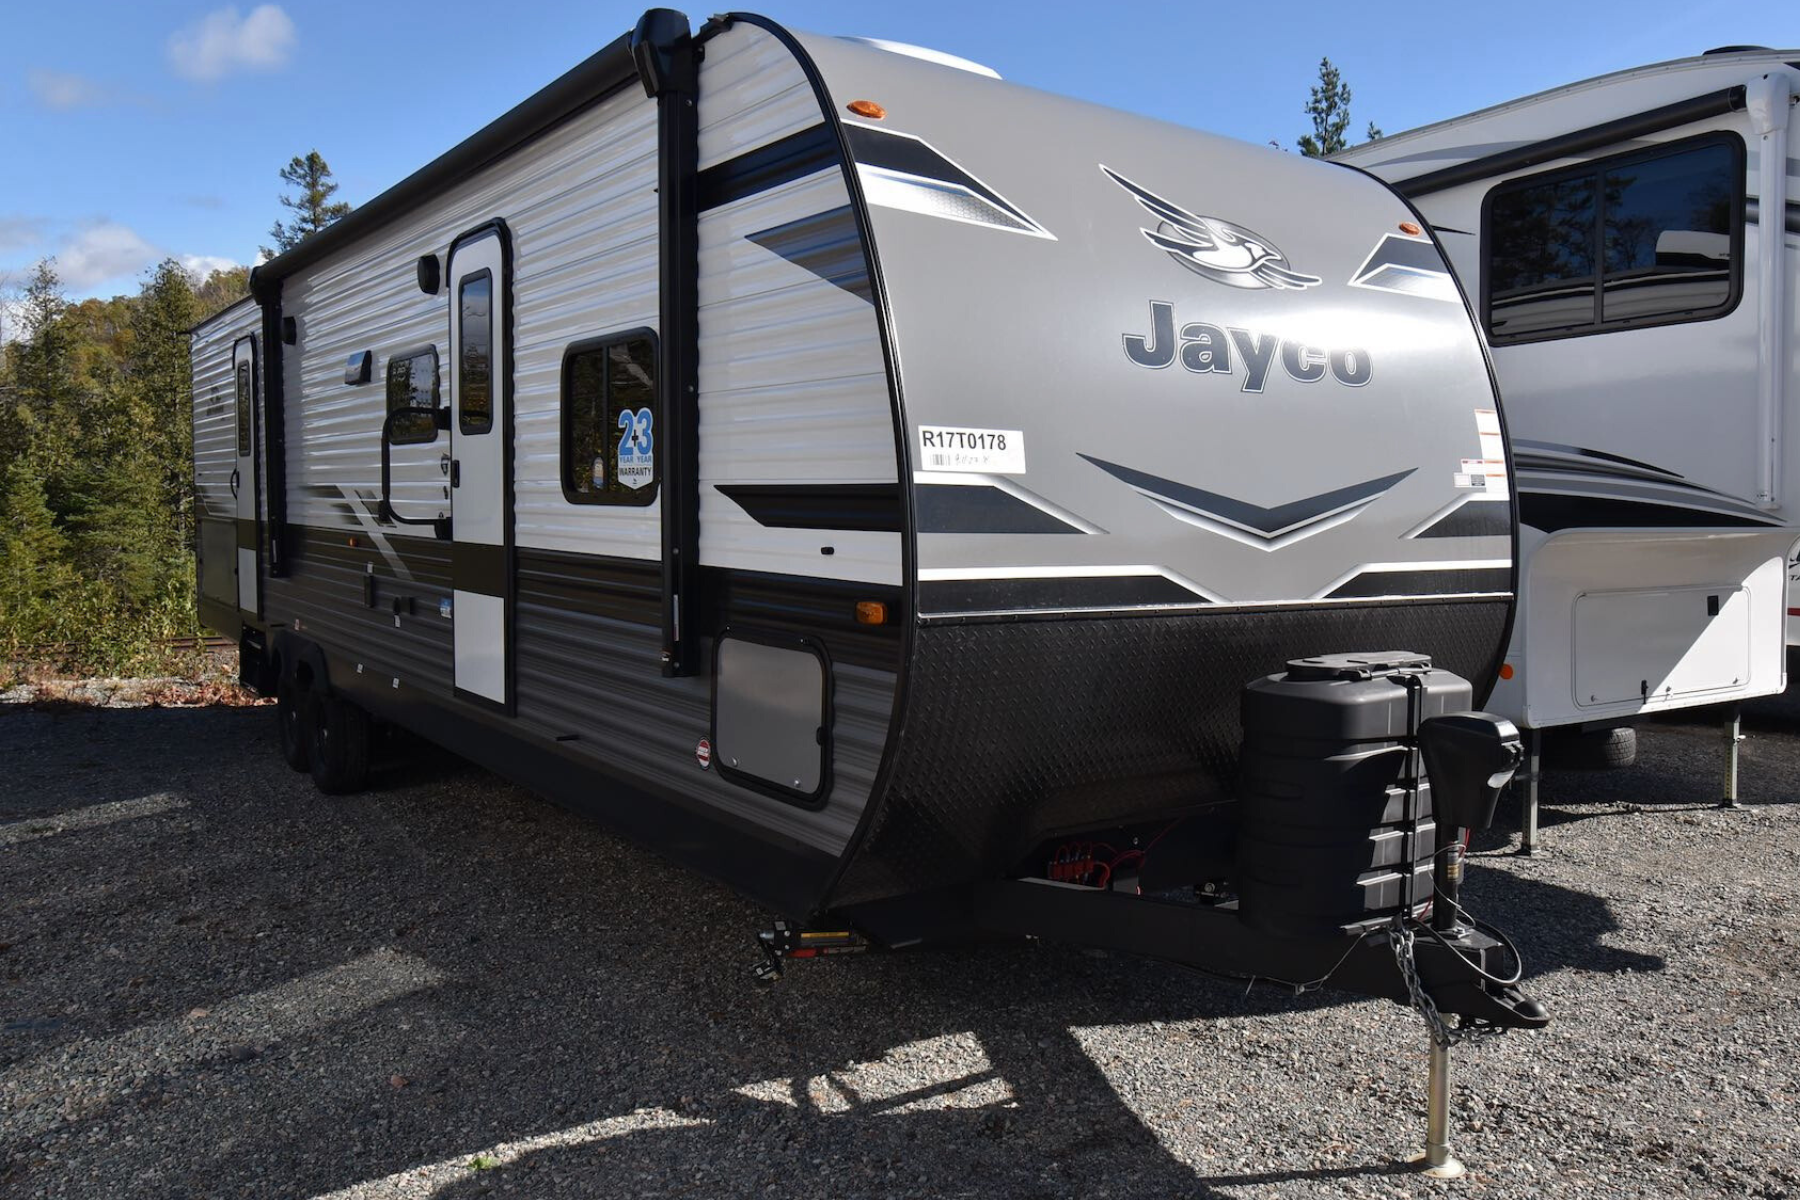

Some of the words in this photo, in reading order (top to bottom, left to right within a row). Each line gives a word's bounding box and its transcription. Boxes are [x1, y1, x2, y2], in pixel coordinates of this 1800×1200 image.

[1122, 300, 1373, 393] Jayco
[922, 430, 1007, 451] R17T0178
[619, 456, 634, 464] YEAR
[637, 455, 652, 464] YEAR
[618, 467, 652, 477] WARRANTY
